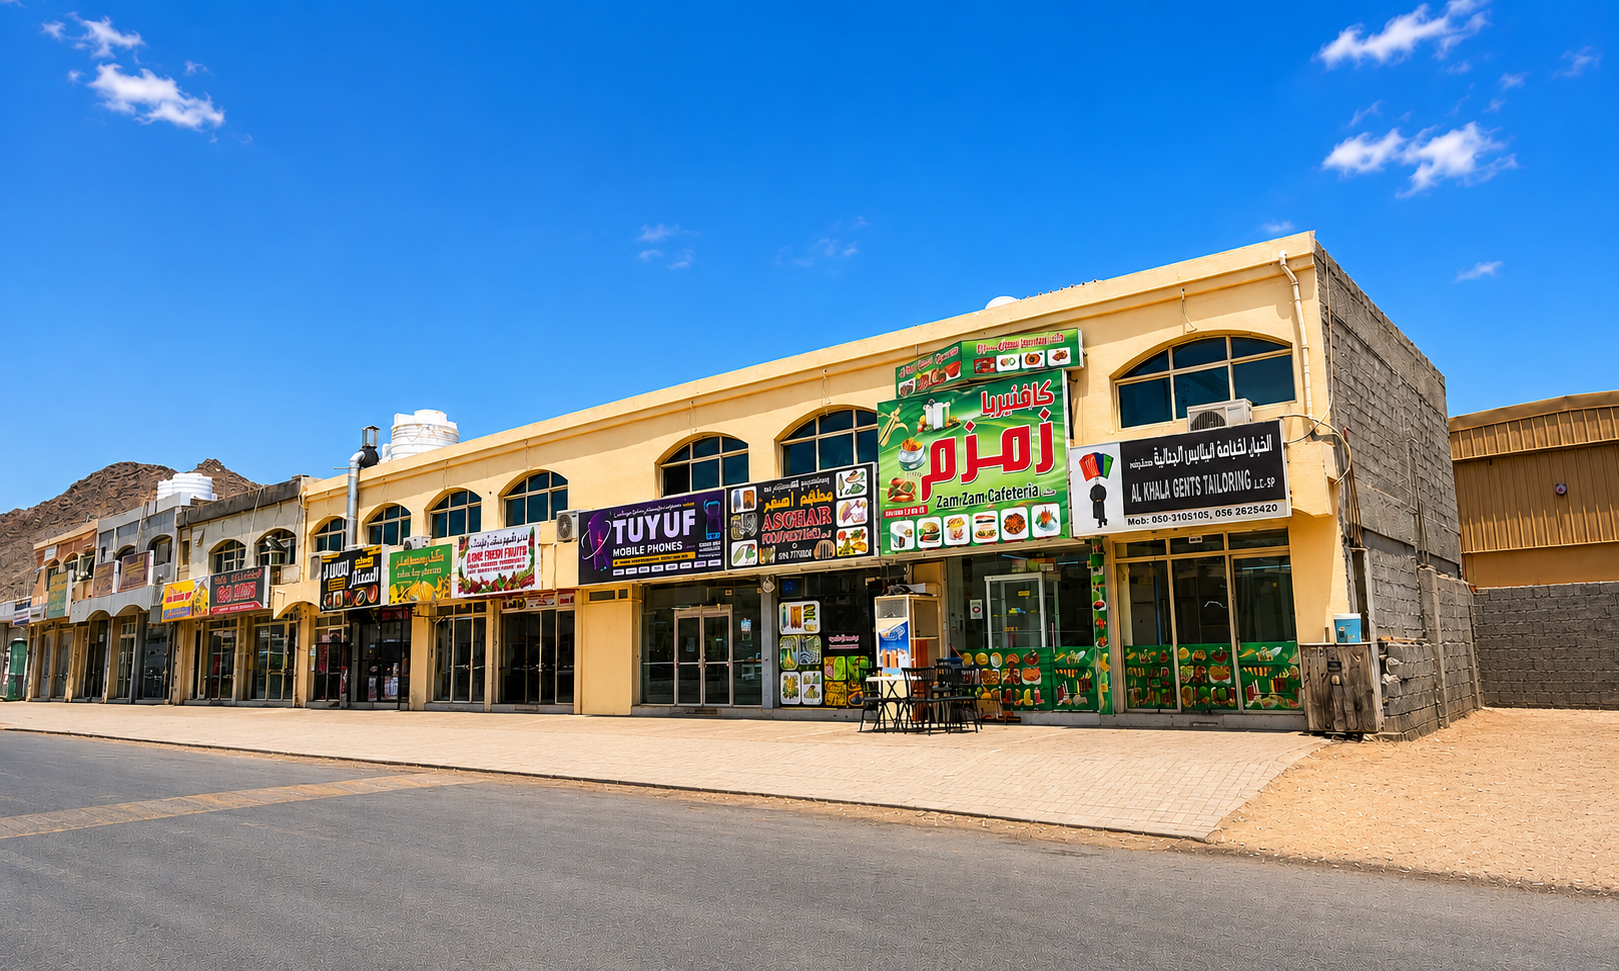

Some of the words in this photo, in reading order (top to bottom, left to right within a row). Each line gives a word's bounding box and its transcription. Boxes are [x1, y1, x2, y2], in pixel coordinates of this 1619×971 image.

[922, 407, 1055, 503] زمزم
[936, 495, 958, 508] Zam
[962, 492, 984, 506] Zam
[988, 482, 1039, 502] Cafeteria
[1132, 484, 1142, 503] AL
[1144, 479, 1170, 501] KHALA
[1173, 476, 1201, 498] GENTS
[1203, 469, 1251, 495] TAILORING
[613, 509, 695, 544] TUYUF
[1128, 518, 1149, 526] Mob:
[1216, 508, 1232, 517] 056
[613, 546, 645, 557] MOBILE
[647, 541, 682, 554] PHONES
